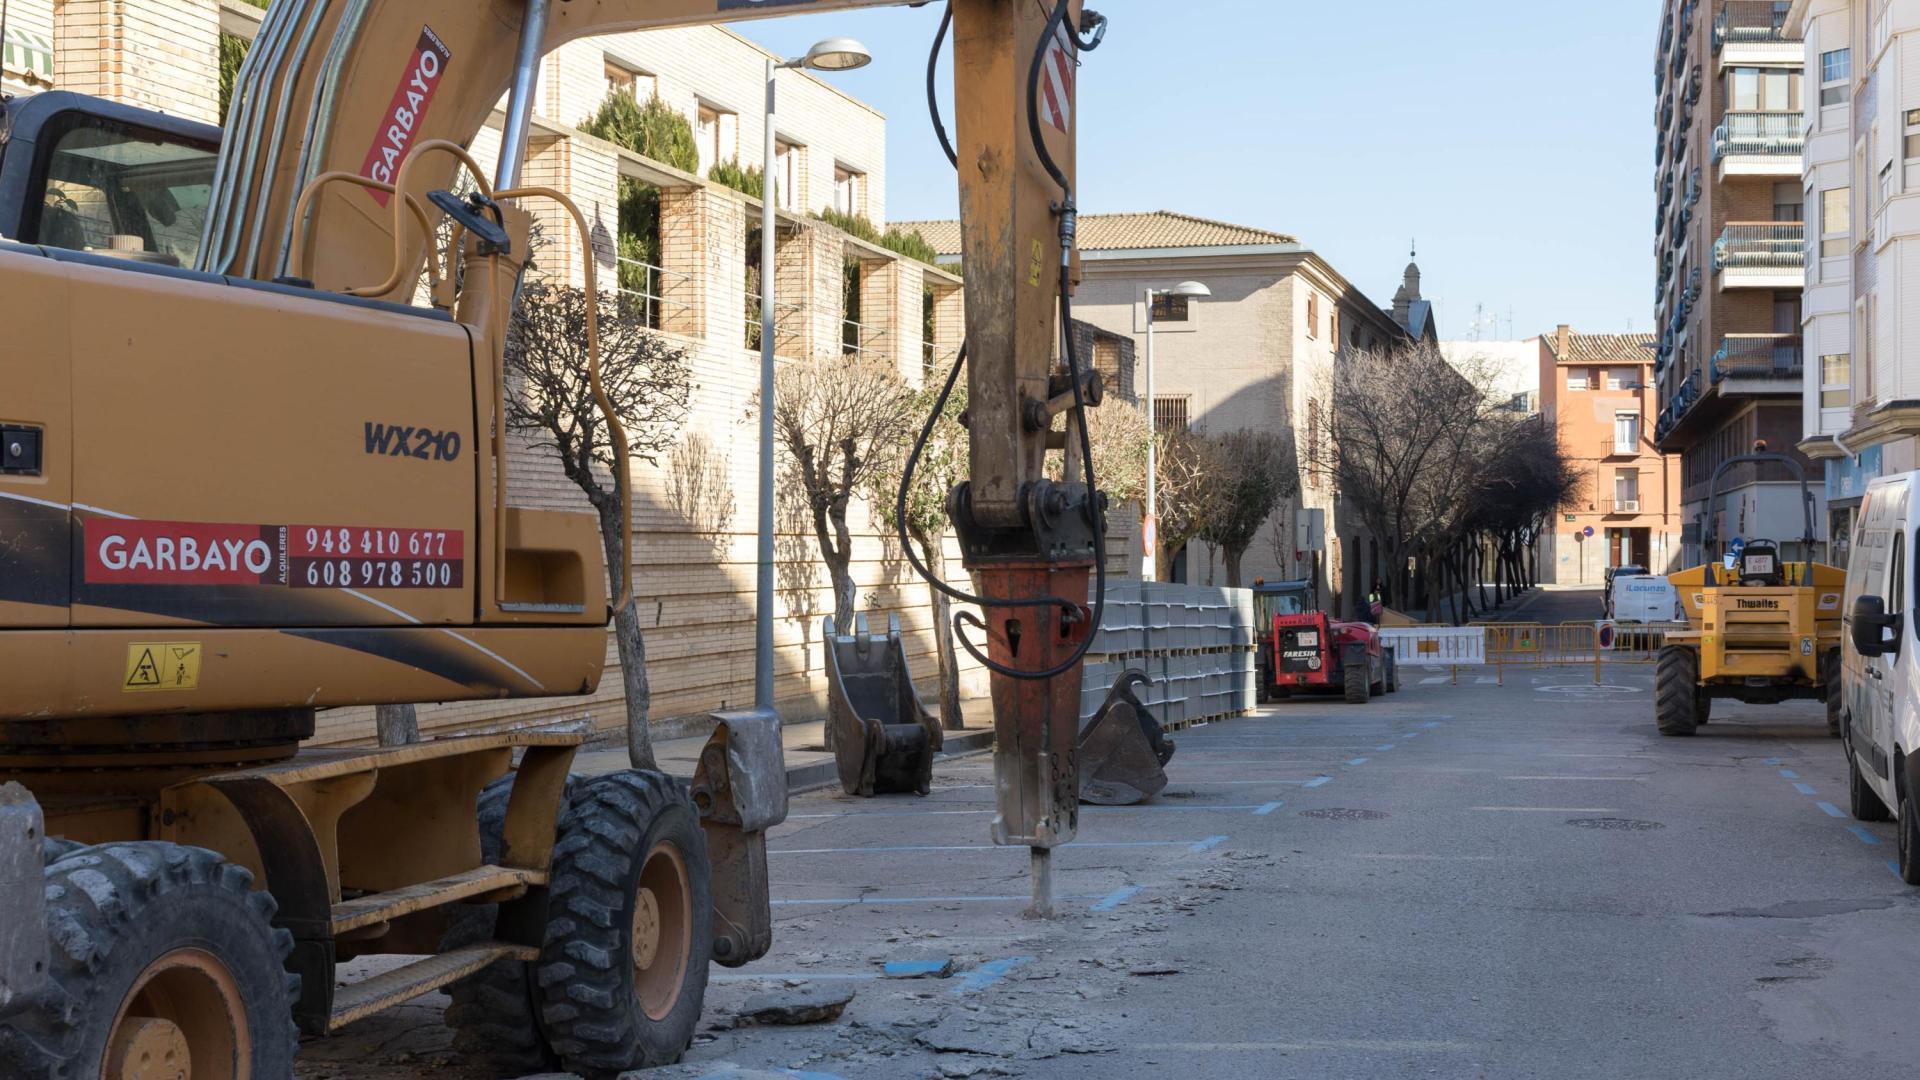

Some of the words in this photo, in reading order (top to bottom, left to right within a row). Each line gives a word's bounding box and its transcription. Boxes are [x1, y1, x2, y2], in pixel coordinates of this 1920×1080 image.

[371, 50, 439, 185] GARBAYO
[364, 422, 461, 462] WX210
[99, 535, 272, 574] GARBAYO
[278, 526, 287, 583] ALQUILERES
[306, 528, 350, 554] 948
[360, 530, 400, 554] 410
[409, 532, 446, 556] 677
[307, 560, 351, 586] 608
[361, 560, 402, 586] 978
[411, 561, 450, 586] 500
[1736, 598, 1779, 608] Thwaites
[1283, 650, 1317, 658] FARESIN
